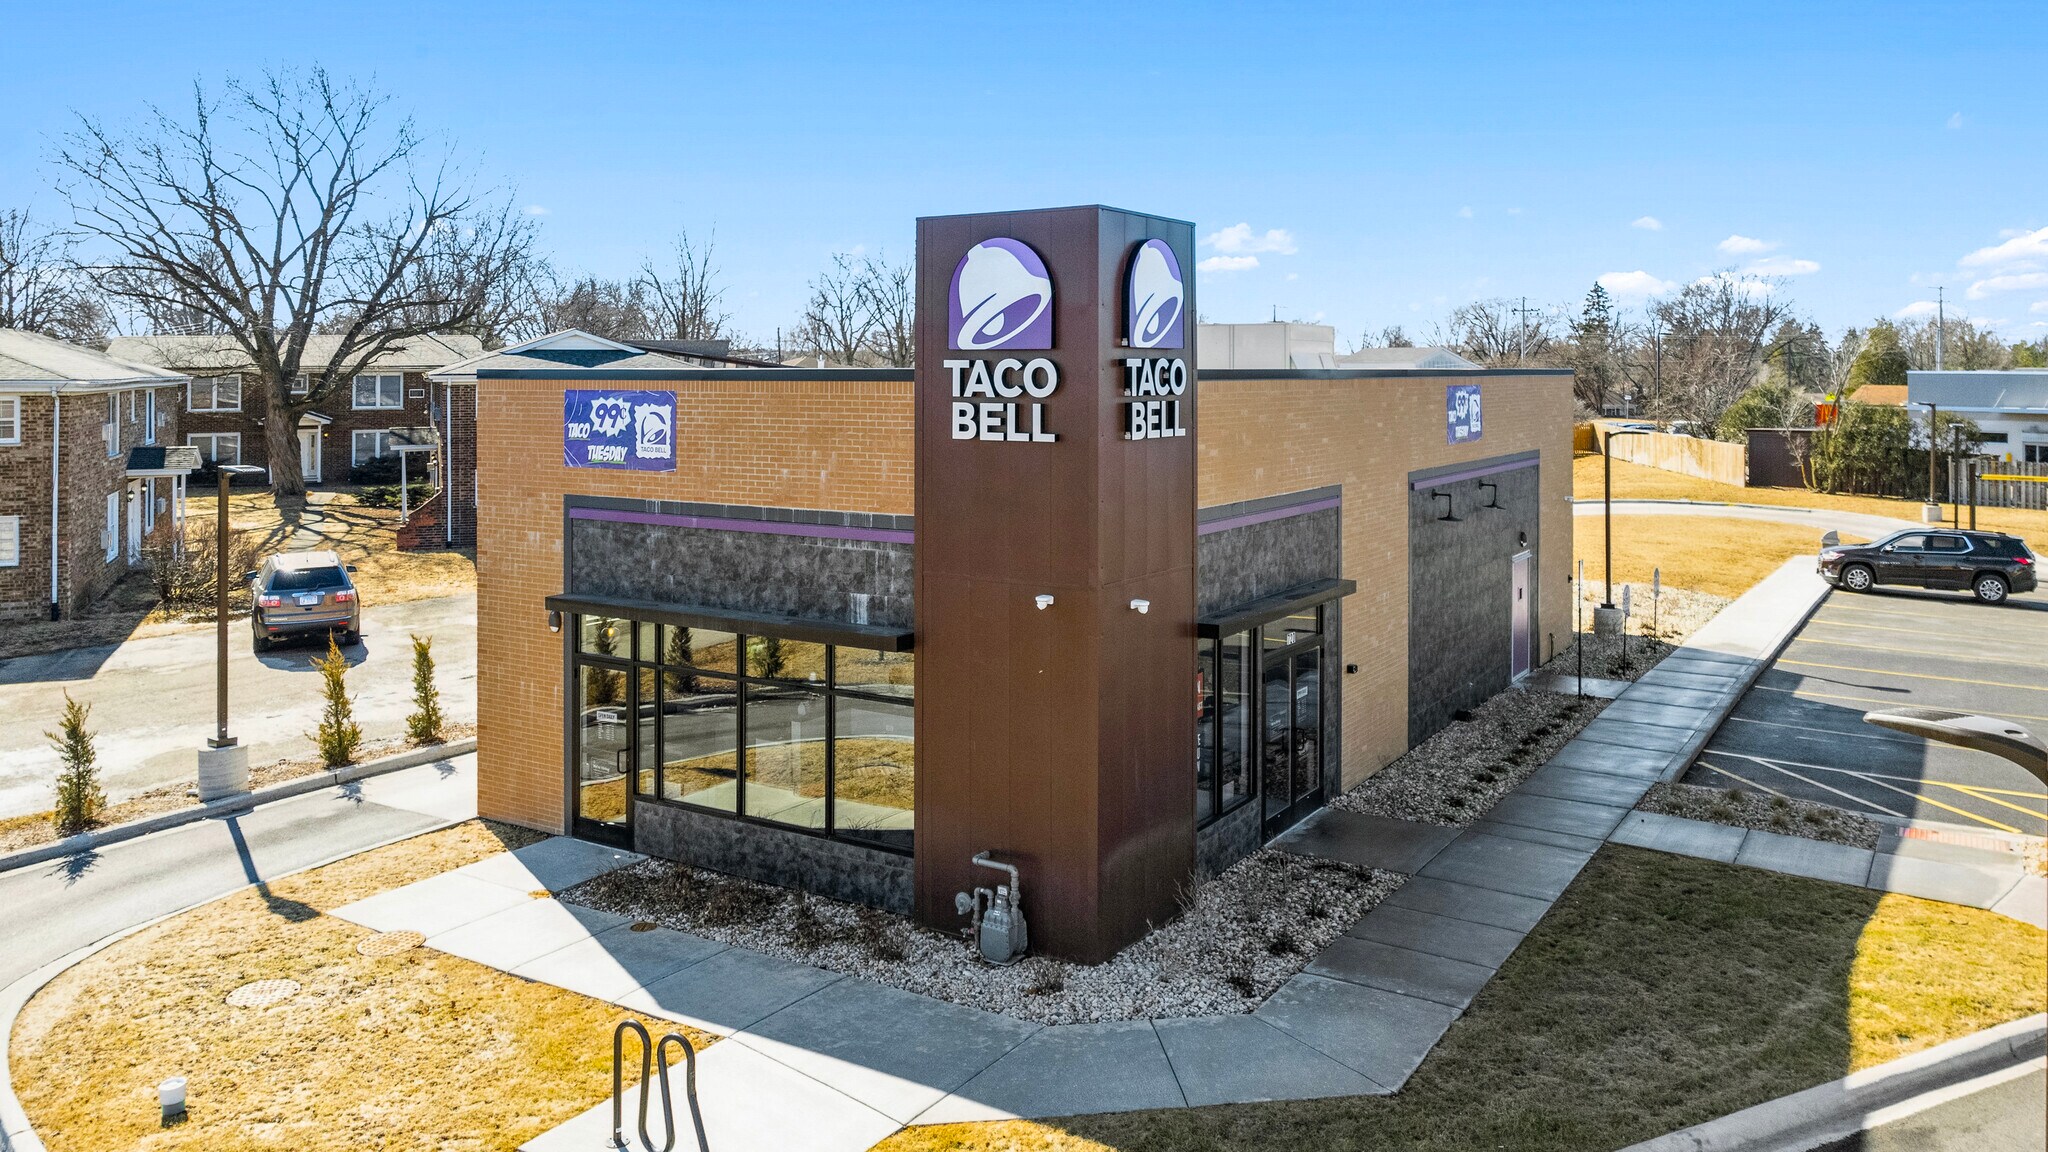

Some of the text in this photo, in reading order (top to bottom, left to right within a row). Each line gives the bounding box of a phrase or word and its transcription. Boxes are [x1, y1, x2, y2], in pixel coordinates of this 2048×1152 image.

[943, 357, 1058, 398] TACO
[1126, 357, 1187, 396] TACO
[568, 422, 590, 438] TACO
[952, 402, 1056, 442] BELL
[1131, 401, 1186, 440] BELL
[587, 445, 628, 461] TUESDAY
